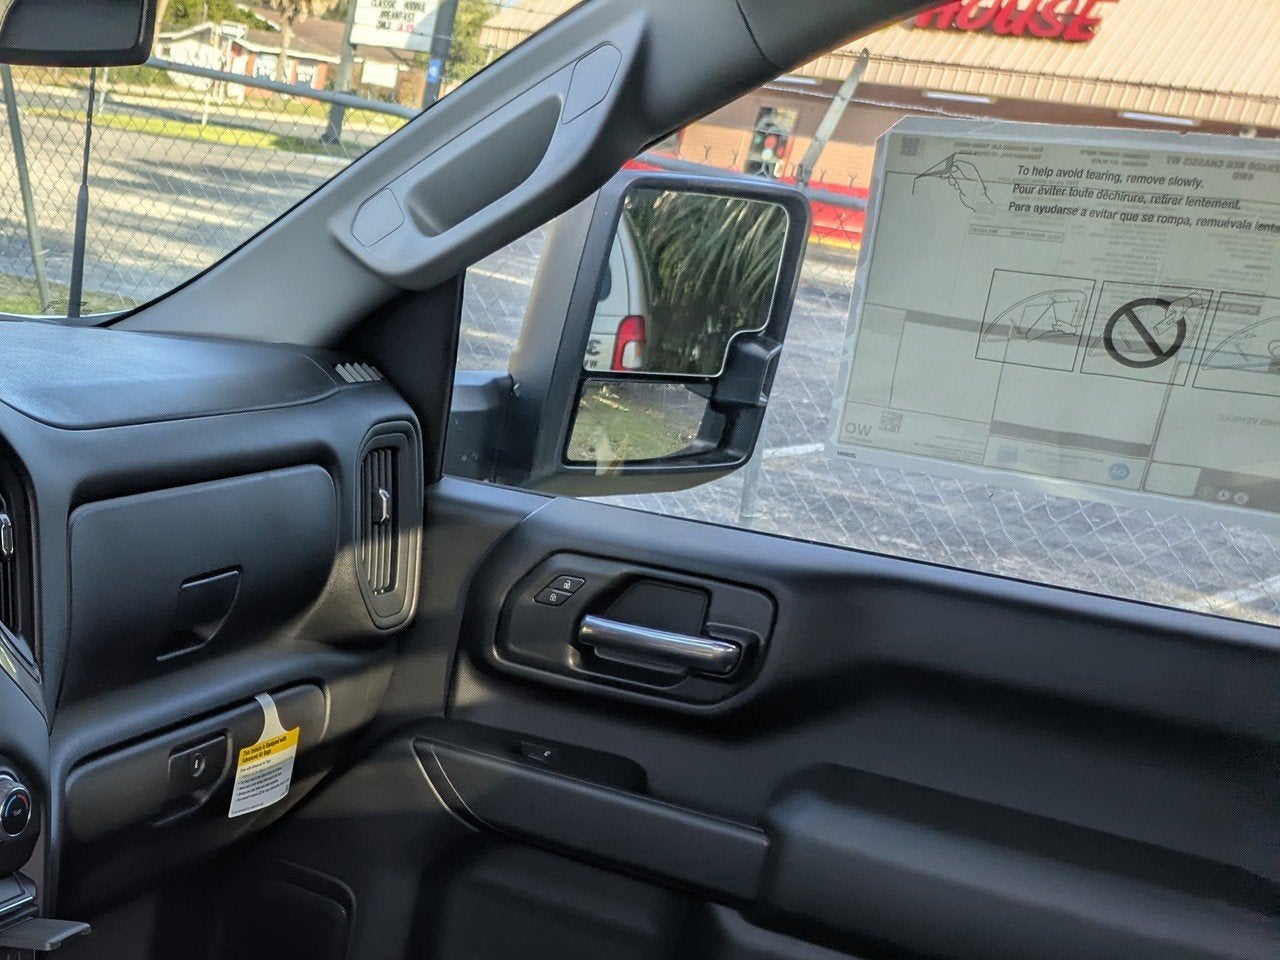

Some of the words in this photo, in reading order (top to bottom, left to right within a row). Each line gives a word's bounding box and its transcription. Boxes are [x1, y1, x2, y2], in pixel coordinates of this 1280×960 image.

[1018, 165, 1029, 176] To
[1032, 165, 1053, 178] help
[1056, 167, 1084, 179] avoid
[1086, 168, 1123, 184] tearing,
[1126, 174, 1165, 186] remove
[1168, 175, 1204, 190] slowly.
[1012, 183, 1036, 195] Pour
[1038, 184, 1067, 197] éviter
[1069, 187, 1094, 198] toute
[1096, 189, 1147, 204] déchirure,
[1150, 193, 1183, 206] retirer
[1185, 196, 1242, 210] lentement.
[1008, 201, 1031, 212] Para
[1033, 203, 1078, 216] ayudarse
[1080, 207, 1087, 217] a
[1089, 208, 1119, 220] evitar
[1120, 211, 1139, 222] que
[1141, 213, 1154, 223] se
[1156, 214, 1193, 228] rompa,
[1195, 217, 1252, 230] remuévala
